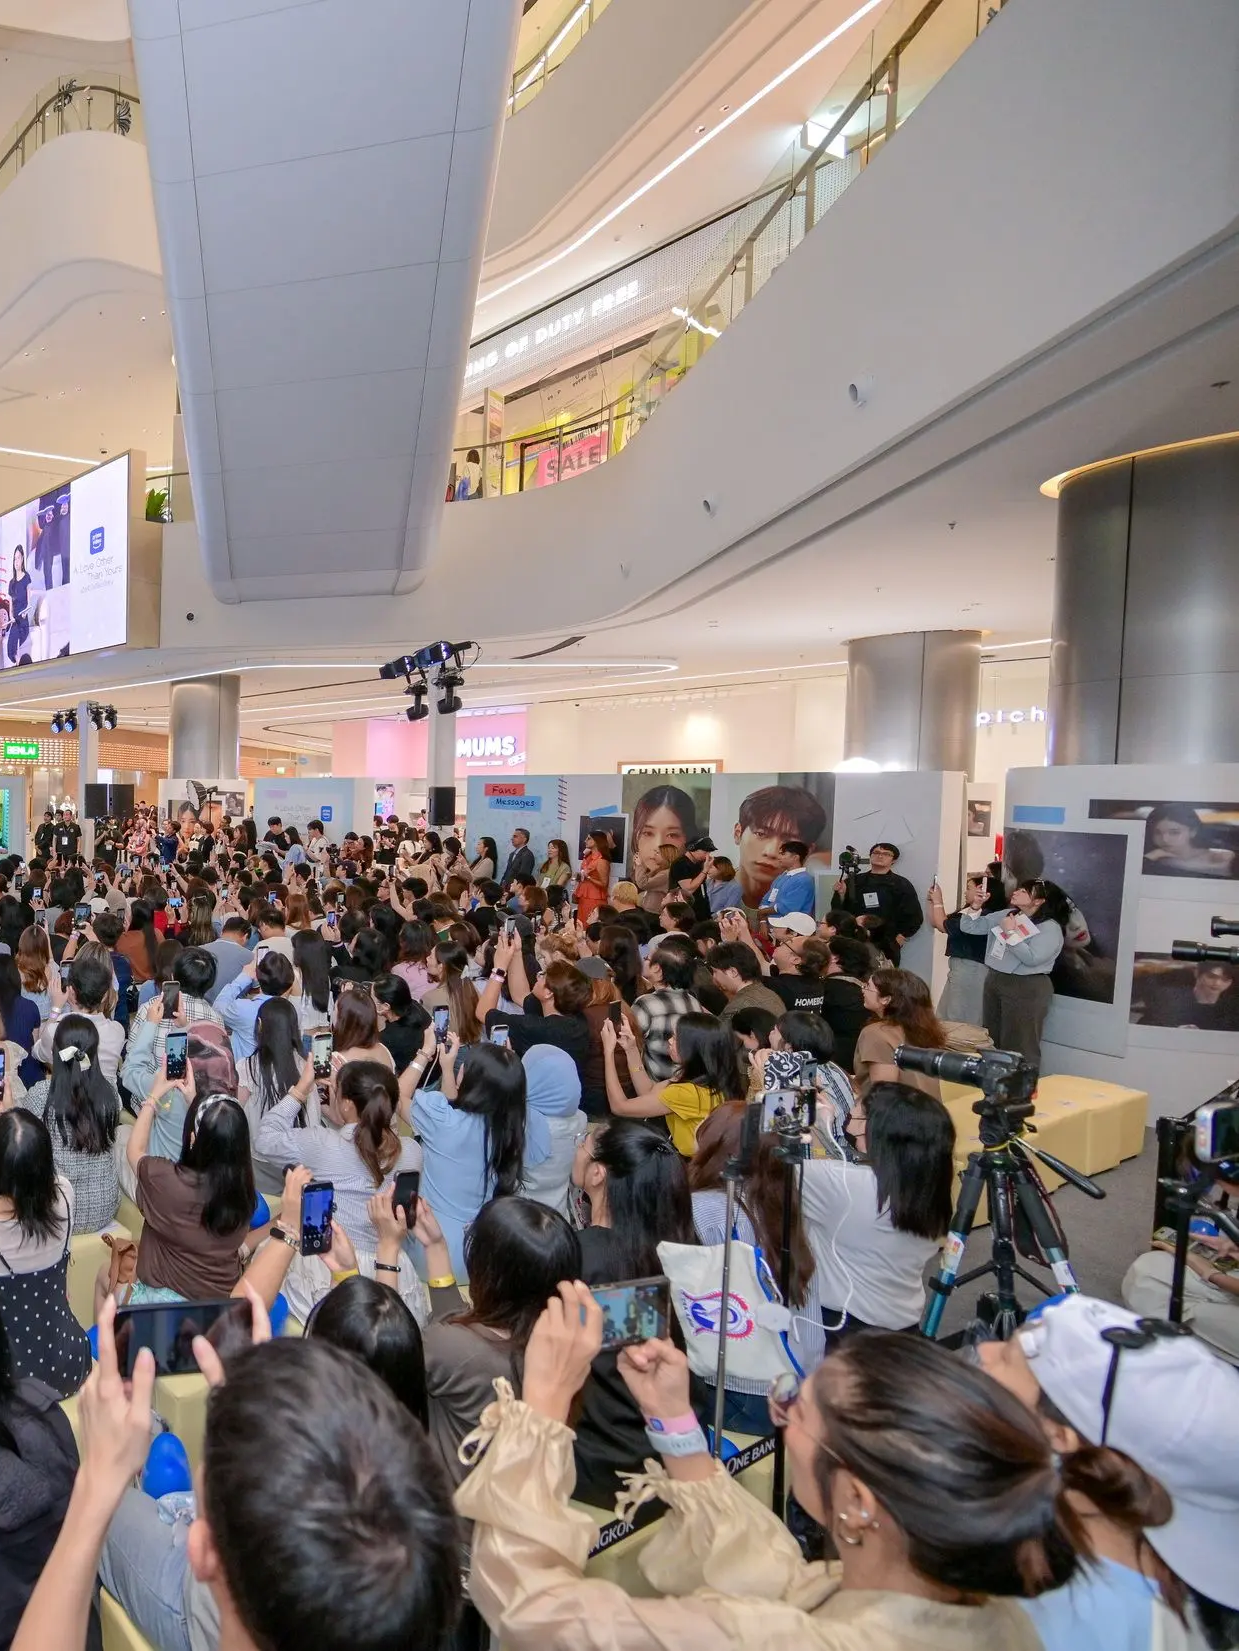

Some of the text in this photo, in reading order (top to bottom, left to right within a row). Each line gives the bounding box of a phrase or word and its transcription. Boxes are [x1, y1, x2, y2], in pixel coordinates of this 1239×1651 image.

[464, 280, 639, 379] ING OF DUTY FREE
[546, 443, 601, 478] SALE
[6, 745, 36, 756] BENLAI
[456, 735, 515, 758] MUMS
[492, 785, 518, 795] Fans
[495, 798, 535, 809] Messages
[727, 1437, 776, 1475] ONE BAN
